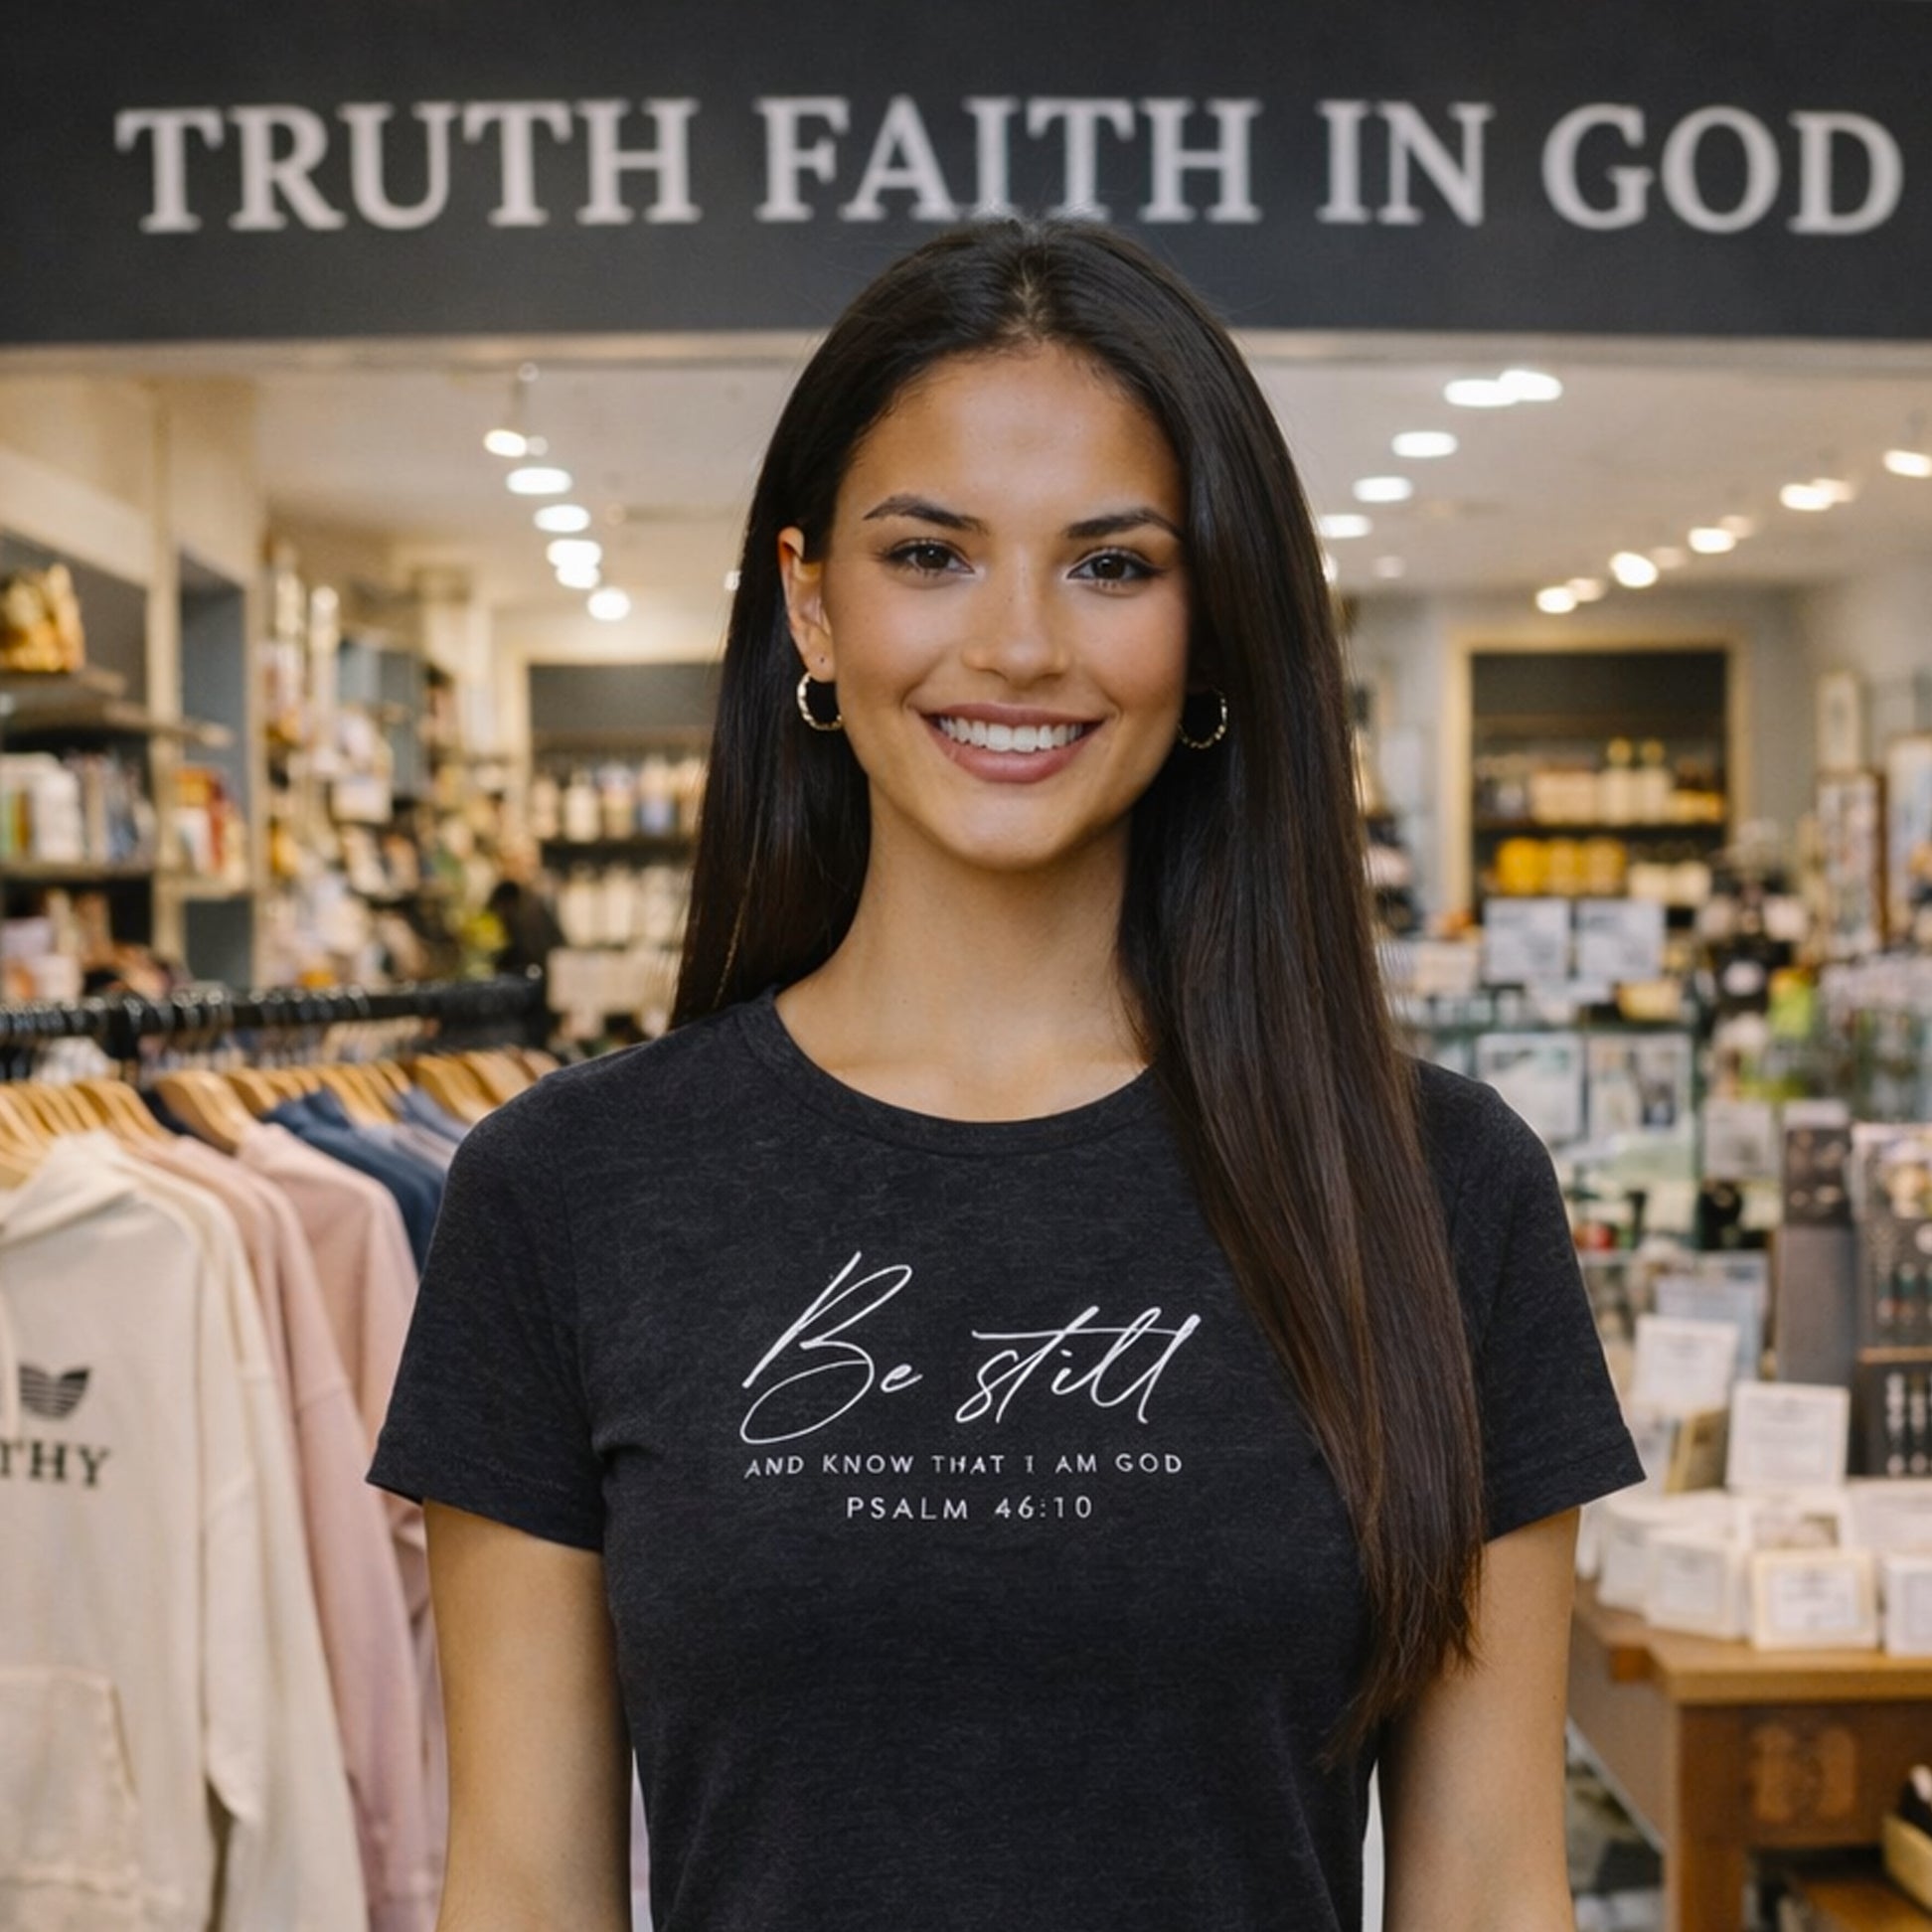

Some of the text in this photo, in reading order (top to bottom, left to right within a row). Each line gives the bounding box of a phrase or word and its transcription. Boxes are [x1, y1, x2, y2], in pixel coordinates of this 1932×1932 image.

[114, 95, 1903, 235] TRUTH FAITH IN GOD
[739, 1250, 1202, 1445] Be still
[743, 1452, 1183, 1479] AND KNOW THAT I AM GOD
[847, 1495, 1093, 1521] PSALM 46:10
